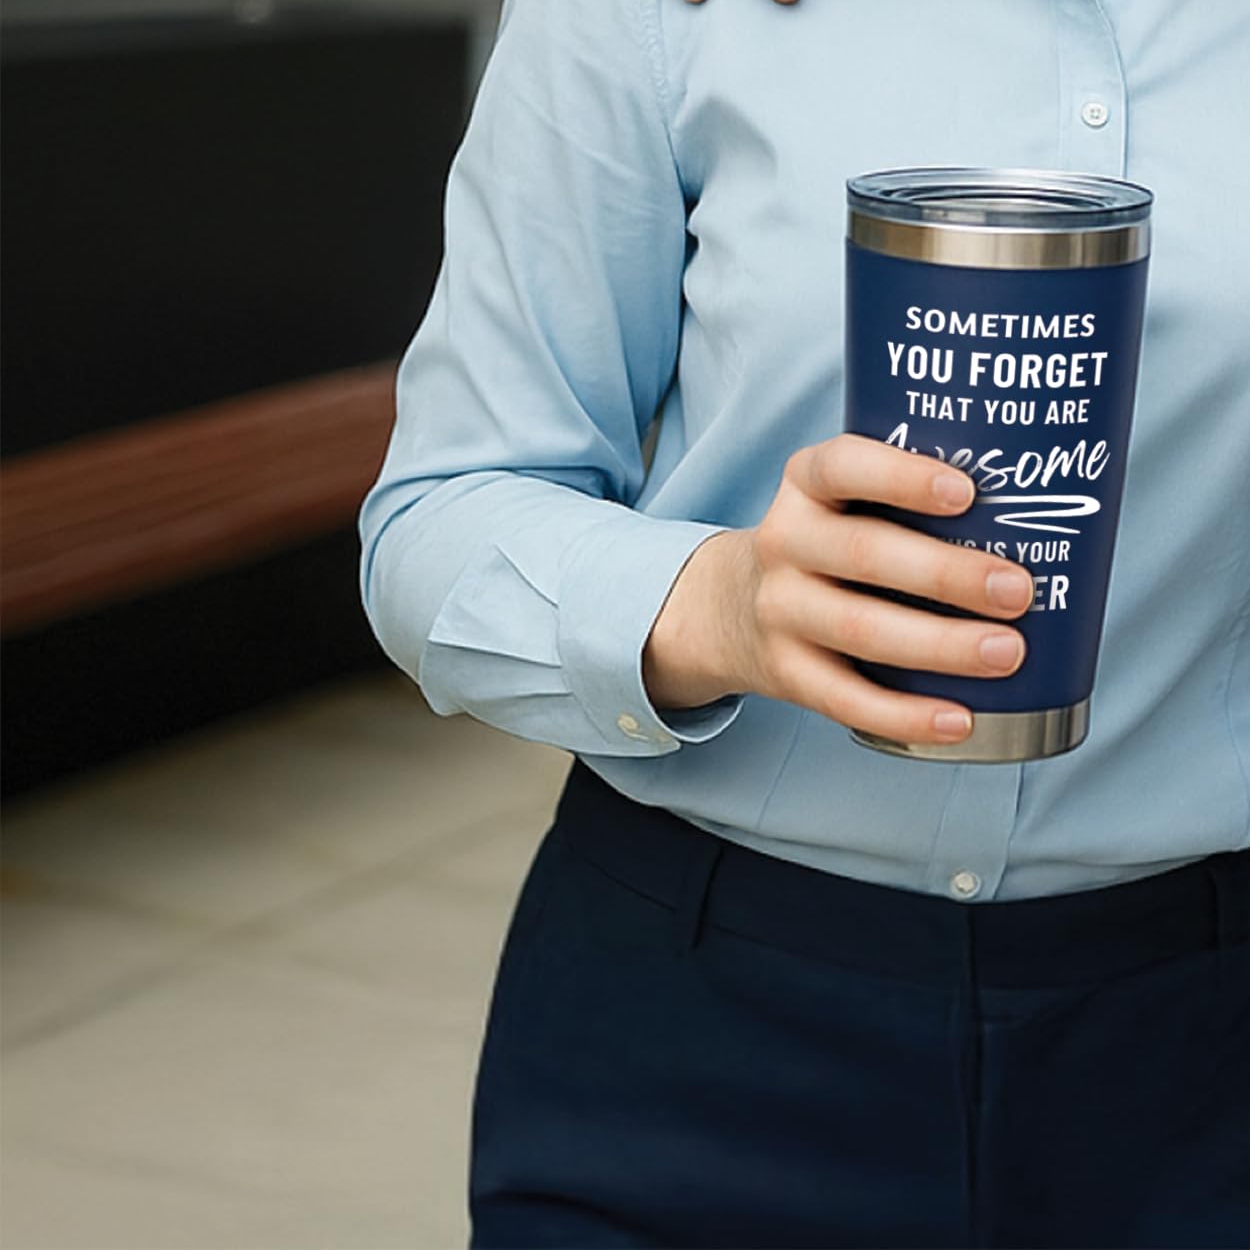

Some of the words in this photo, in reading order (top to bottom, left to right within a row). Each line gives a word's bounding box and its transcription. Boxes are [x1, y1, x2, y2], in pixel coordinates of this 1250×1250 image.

[905, 306, 1096, 339] SOMETIMES
[887, 341, 954, 384] YOU
[969, 351, 1109, 389] FORGET
[906, 390, 974, 422] THAT
[984, 399, 1036, 426] YOU
[1044, 398, 1090, 425] ARE
[884, 421, 1111, 492] esome
[1015, 540, 1072, 564] YOUR
